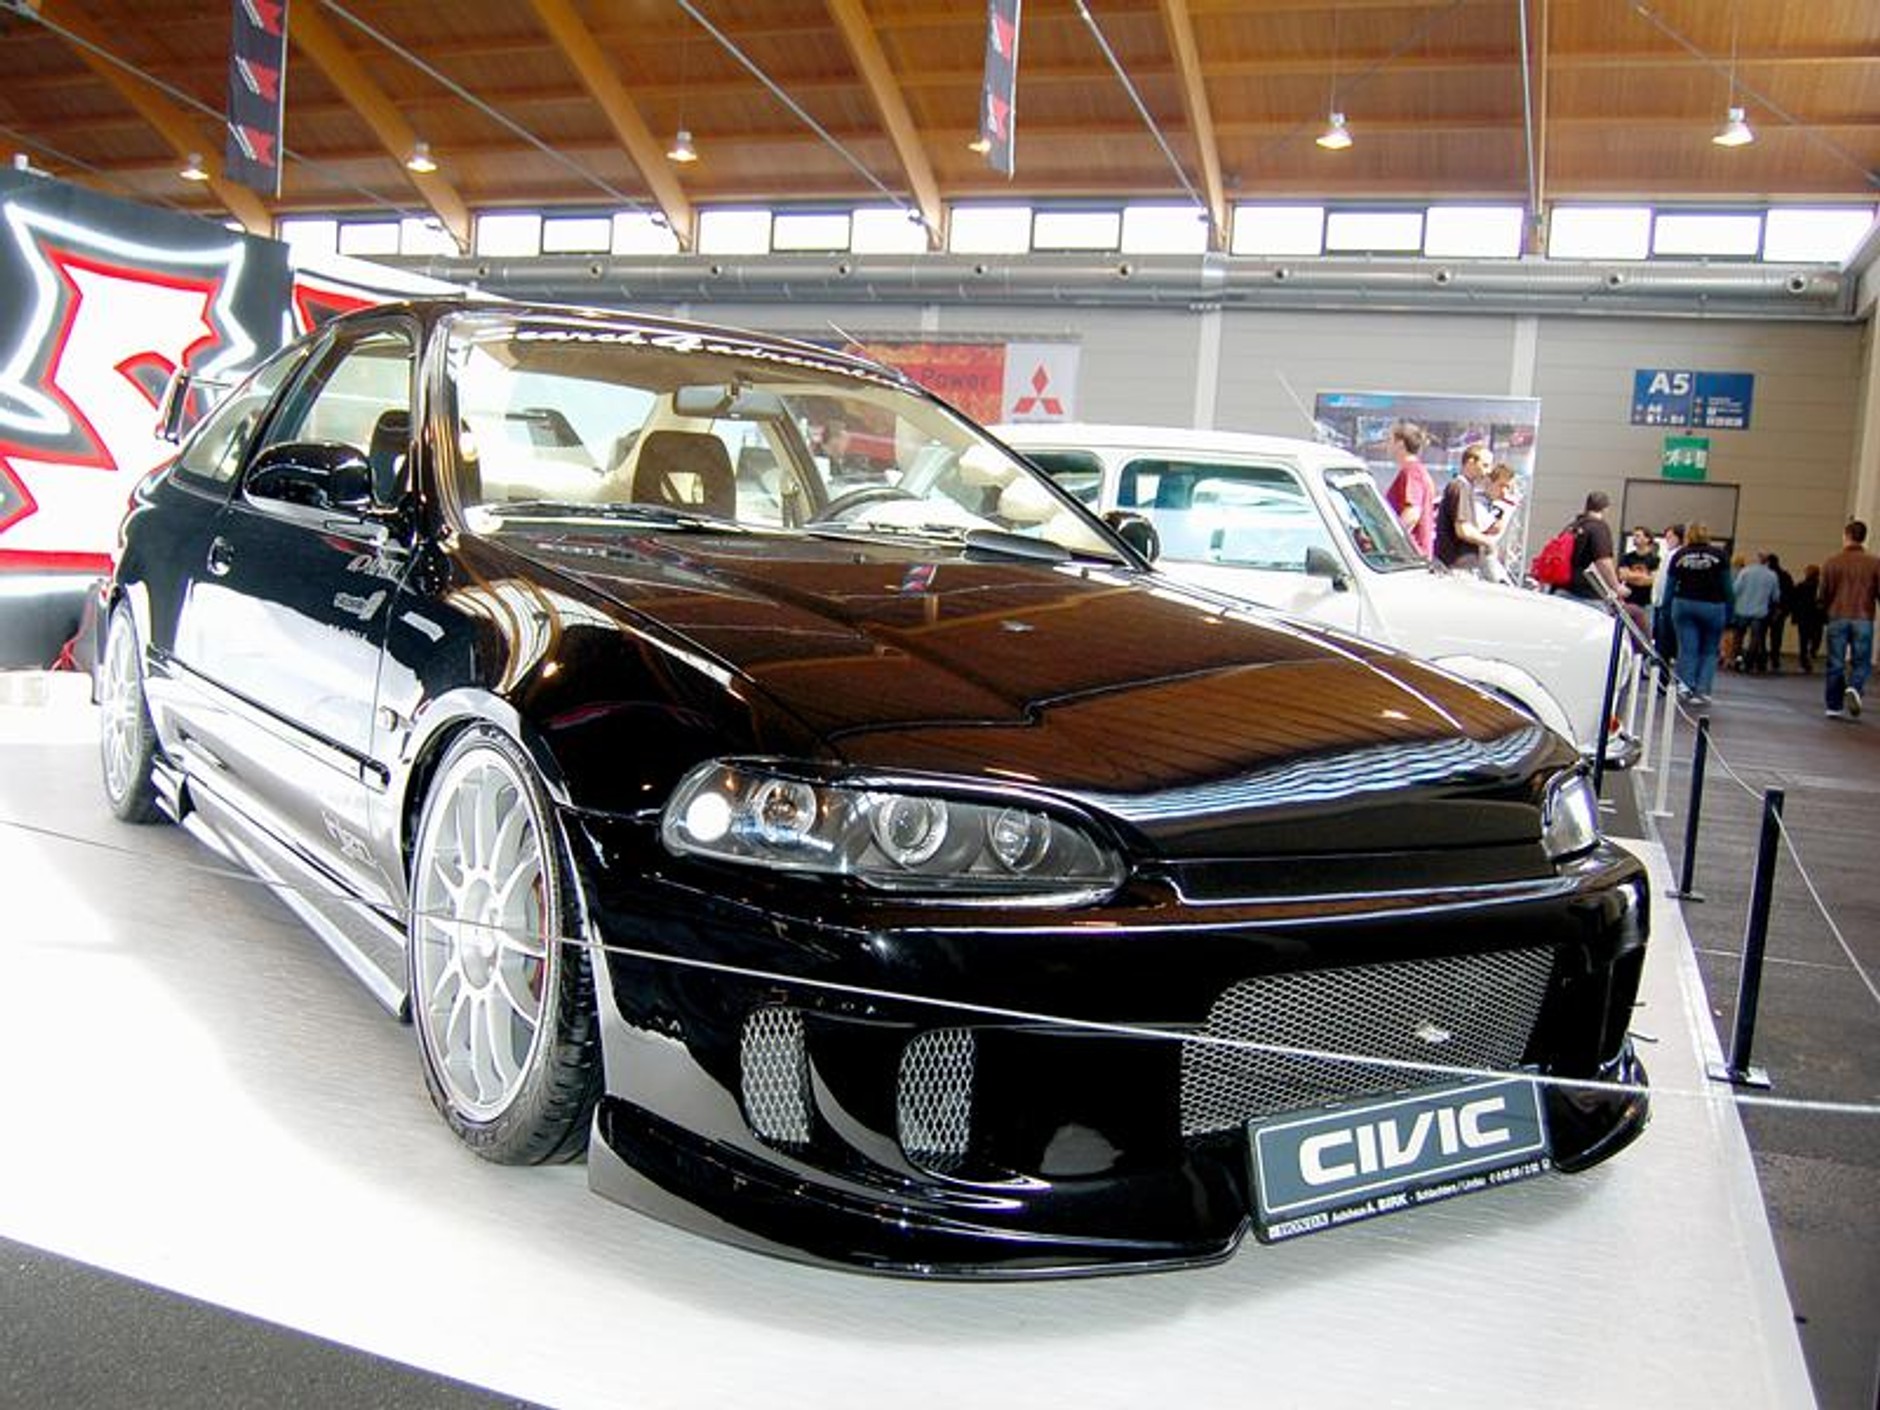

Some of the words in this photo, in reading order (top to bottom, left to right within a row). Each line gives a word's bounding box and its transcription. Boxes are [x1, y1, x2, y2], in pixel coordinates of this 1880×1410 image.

[921, 368, 991, 390] Power
[1648, 372, 1690, 395] A5
[1299, 1097, 1511, 1186] CIVIC
